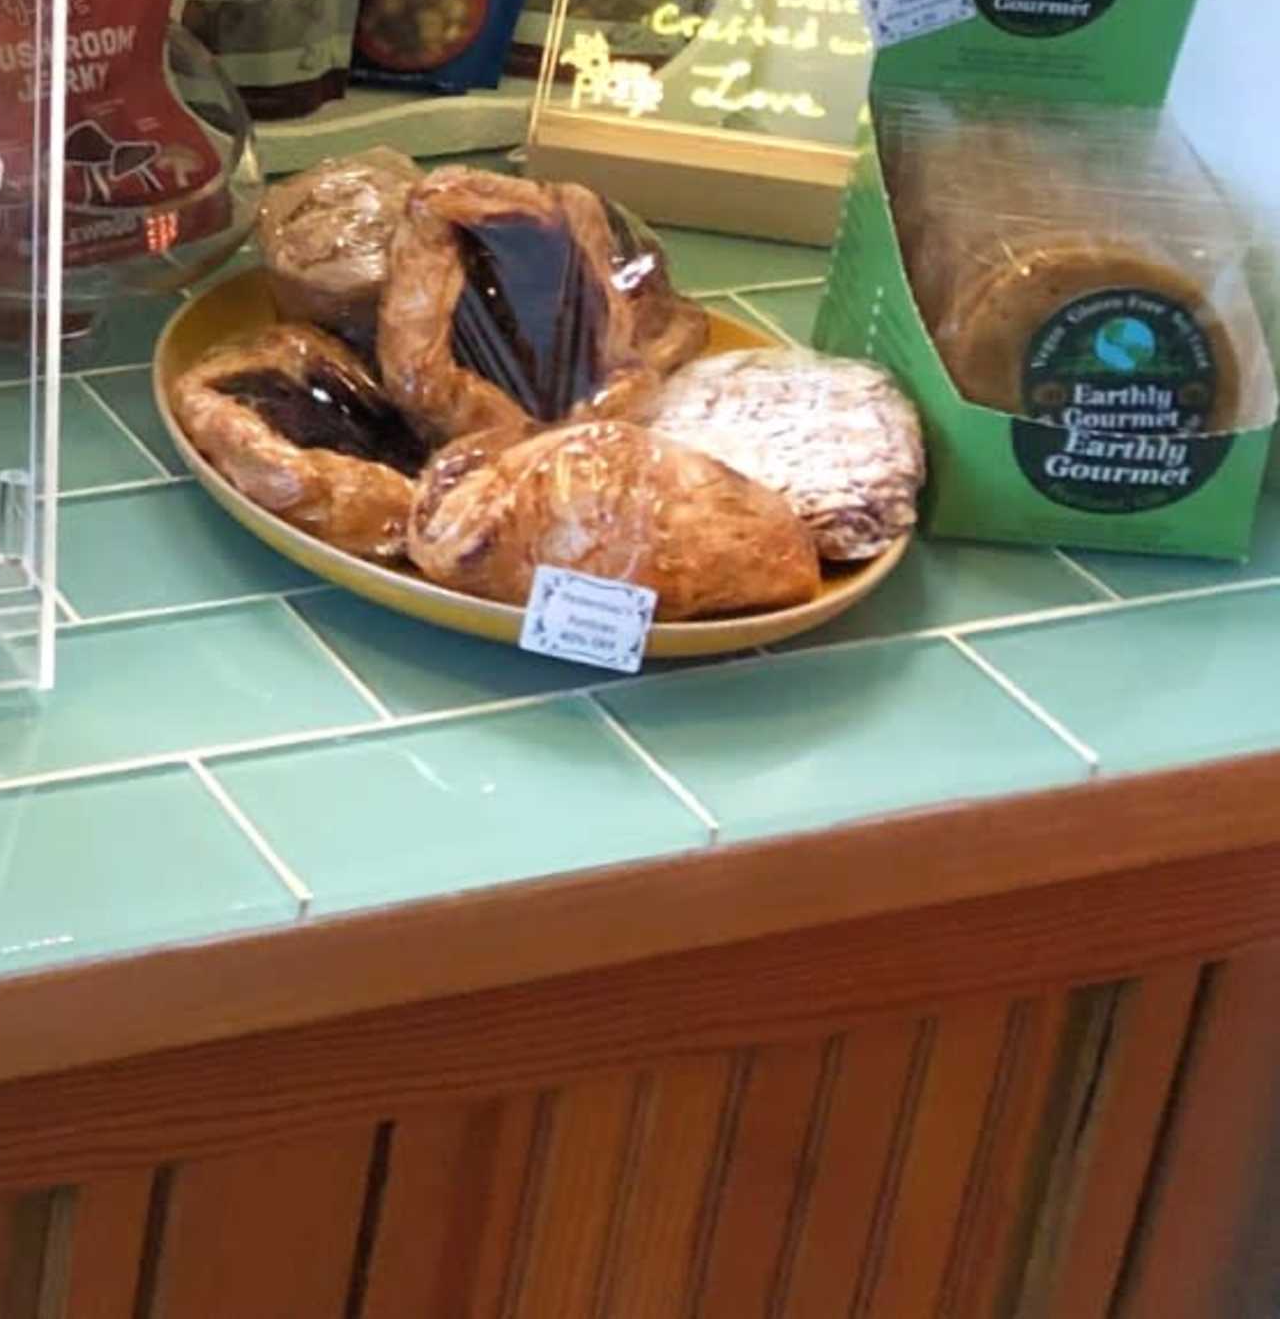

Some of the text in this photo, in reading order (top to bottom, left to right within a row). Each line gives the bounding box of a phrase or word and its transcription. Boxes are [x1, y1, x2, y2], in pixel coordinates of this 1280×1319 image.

[652, 3, 820, 51] Crafted
[689, 60, 827, 118] Love
[1072, 383, 1172, 410] Earthly
[1062, 407, 1180, 430] Gourmet
[1063, 430, 1189, 466] Earthly
[1043, 454, 1191, 486] Gourmet
